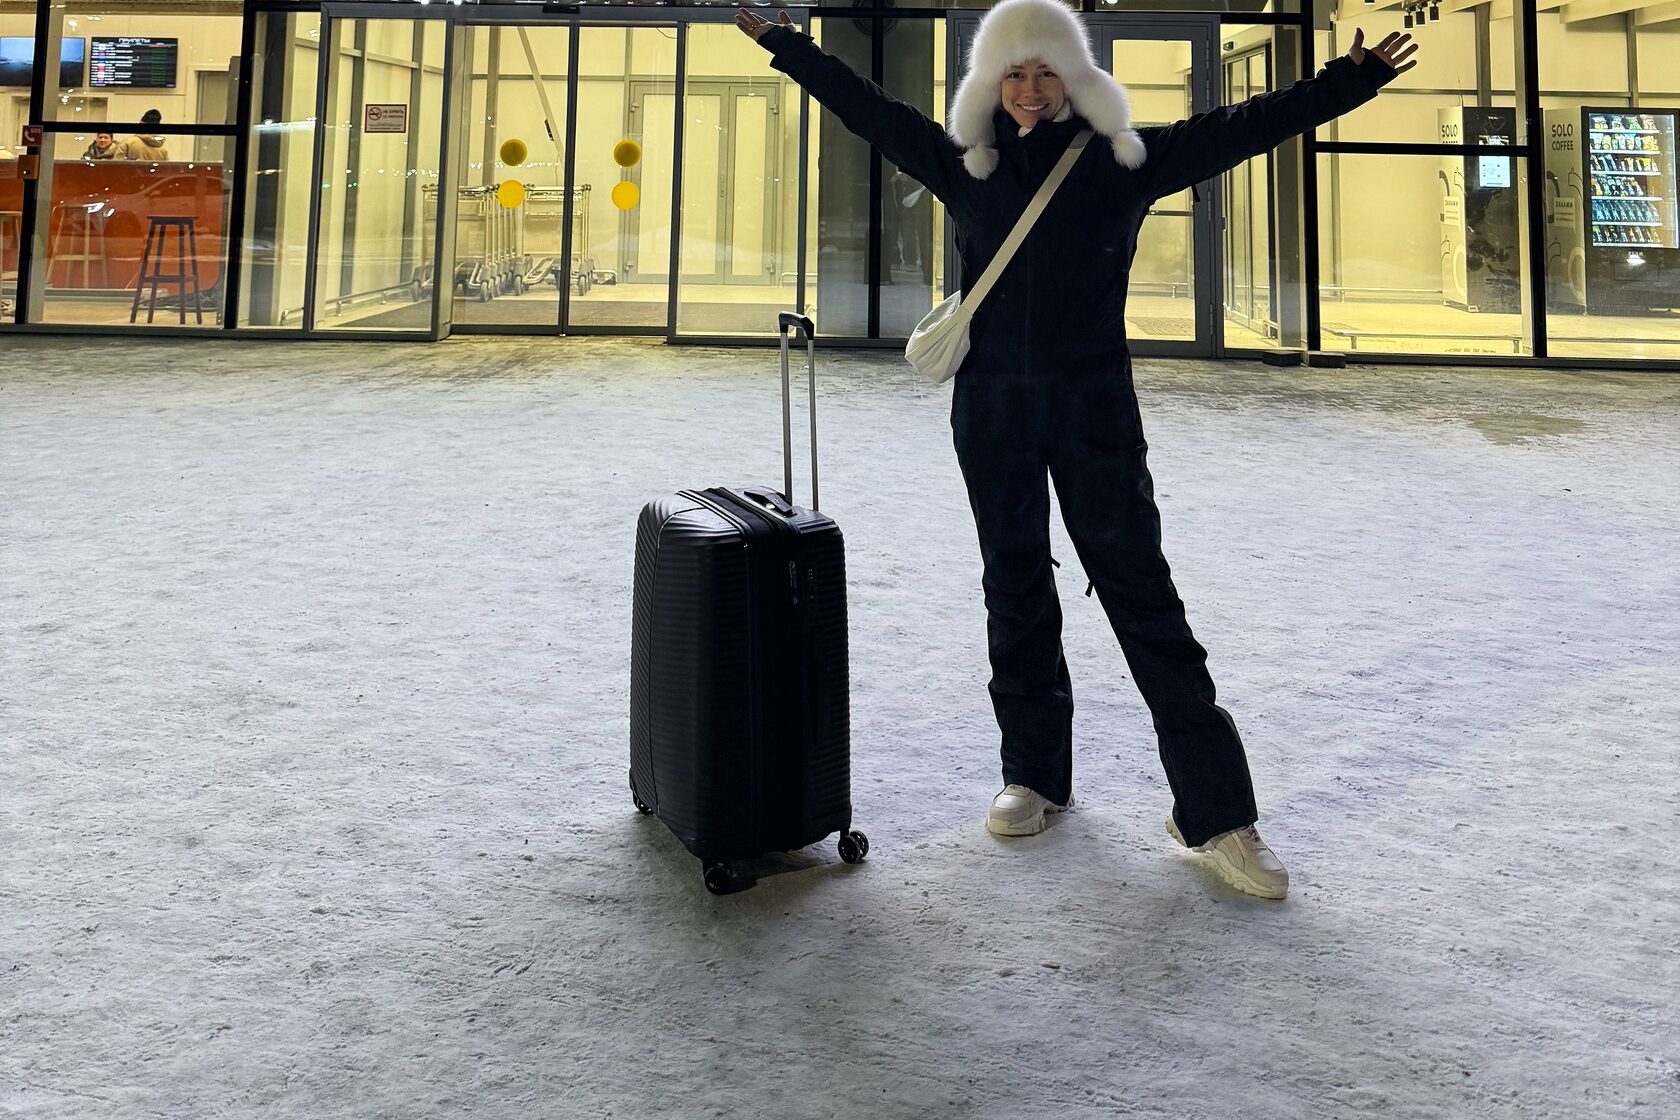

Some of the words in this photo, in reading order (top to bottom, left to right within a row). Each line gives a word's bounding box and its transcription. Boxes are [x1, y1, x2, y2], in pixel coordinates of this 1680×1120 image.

[1441, 124, 1458, 137] SOLO
[1551, 123, 1574, 138] SOLO
[1552, 140, 1574, 151] COFFEE
